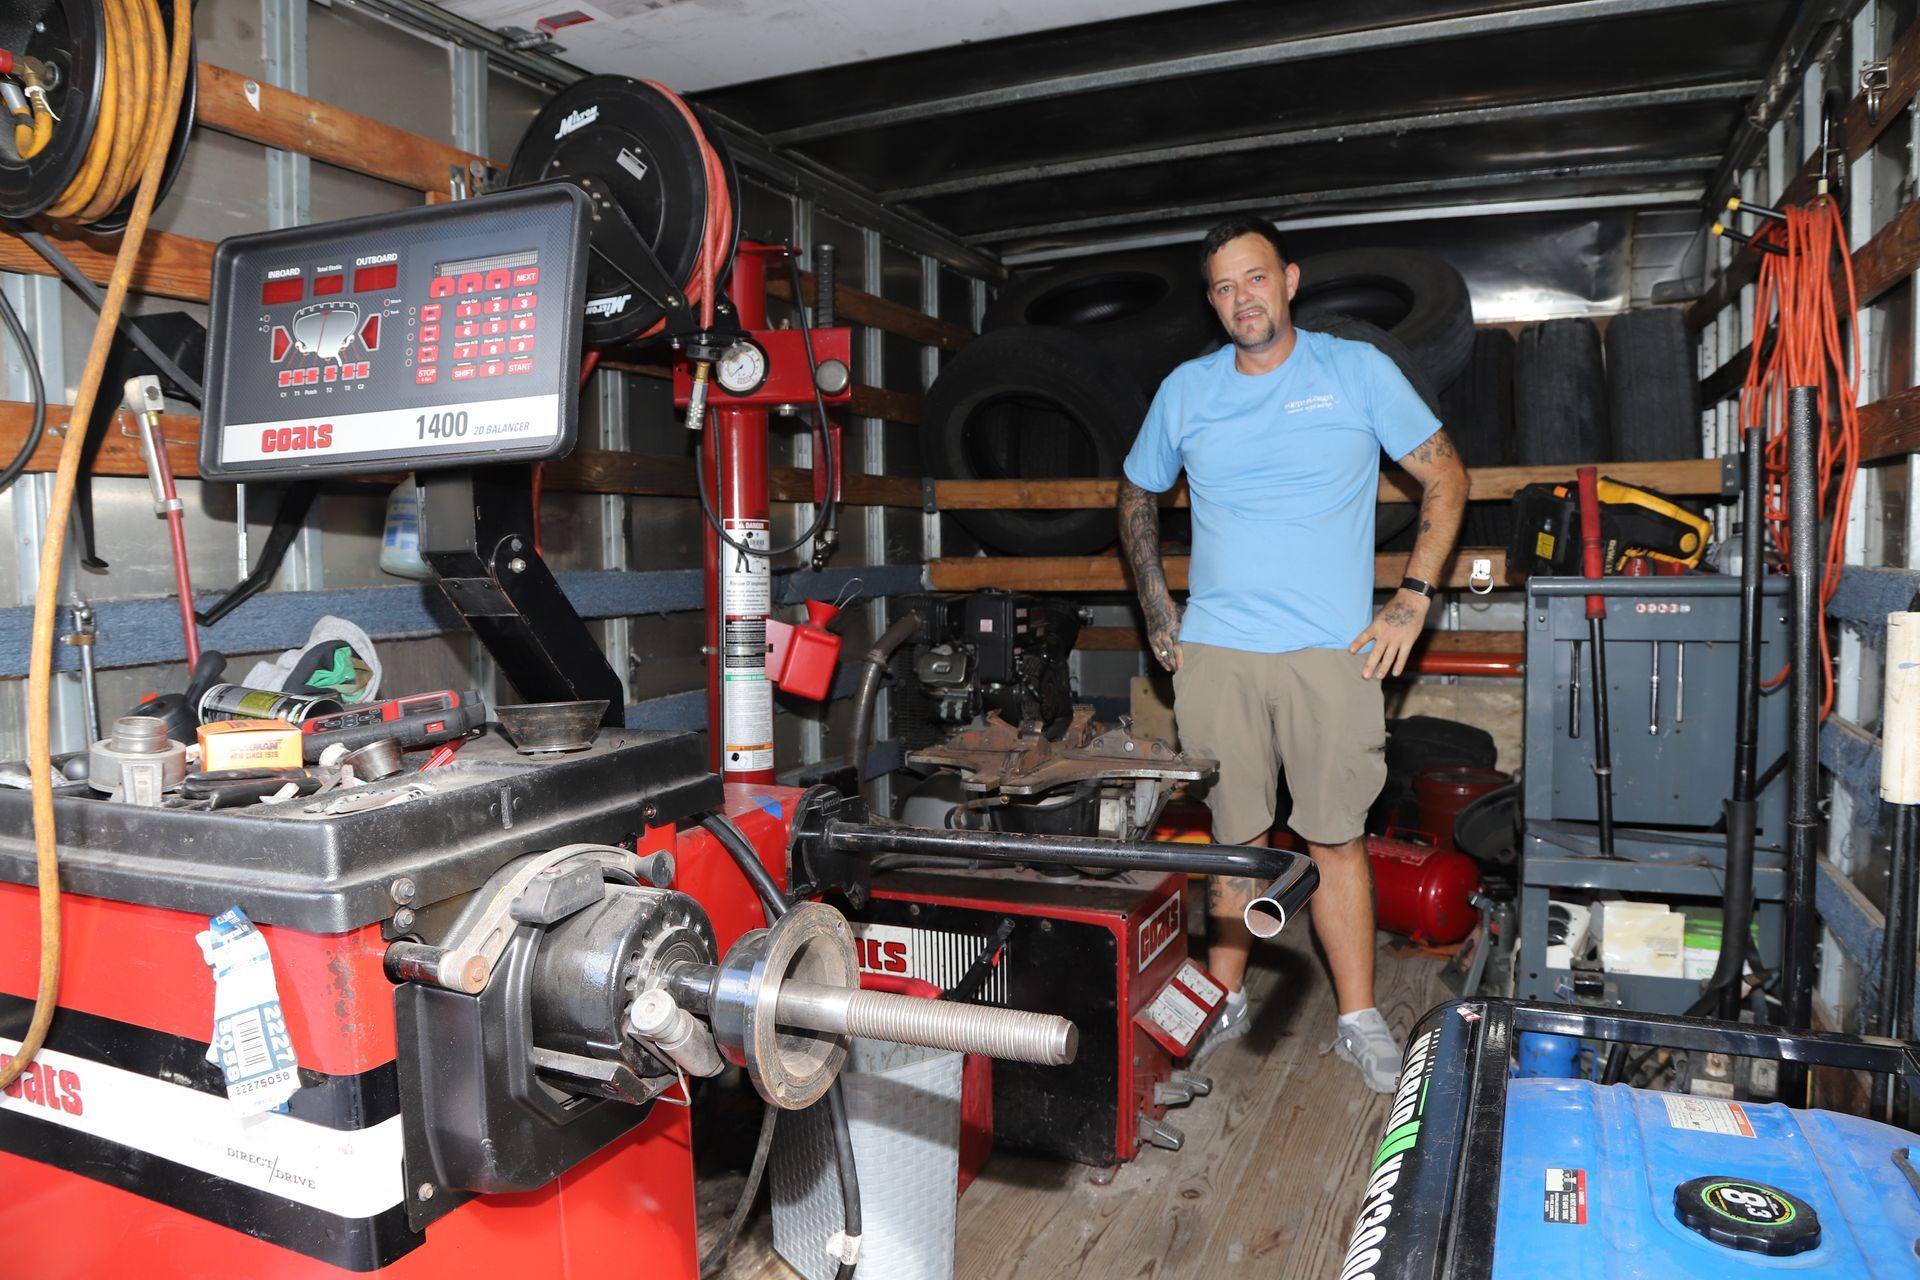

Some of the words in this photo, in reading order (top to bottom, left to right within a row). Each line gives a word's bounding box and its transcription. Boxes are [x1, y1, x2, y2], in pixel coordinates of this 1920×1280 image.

[356, 253, 398, 266] OUTBOARD
[268, 267, 300, 279] INBOARD
[516, 272, 537, 282] NEXT
[493, 302, 501, 312] 2
[520, 299, 529, 309] 3
[491, 323, 499, 333] 5
[519, 320, 527, 330] 6
[490, 344, 497, 354] 8
[518, 341, 526, 351] 9
[462, 348, 470, 358] 7
[509, 362, 533, 372] START
[418, 368, 436, 377] STOP
[454, 368, 475, 378] SHIFT
[416, 410, 468, 440] 1400
[473, 426, 485, 436] 2D
[486, 421, 530, 435] BALANCER
[263, 1004, 297, 1068] 2227
[218, 1020, 242, 1083] 5058
[0, 1053, 83, 1117] ats
[235, 1071, 291, 1096] 22275058
[1385, 1031, 1432, 1136] HYBRID
[1720, 1187, 1773, 1219] 8.3
